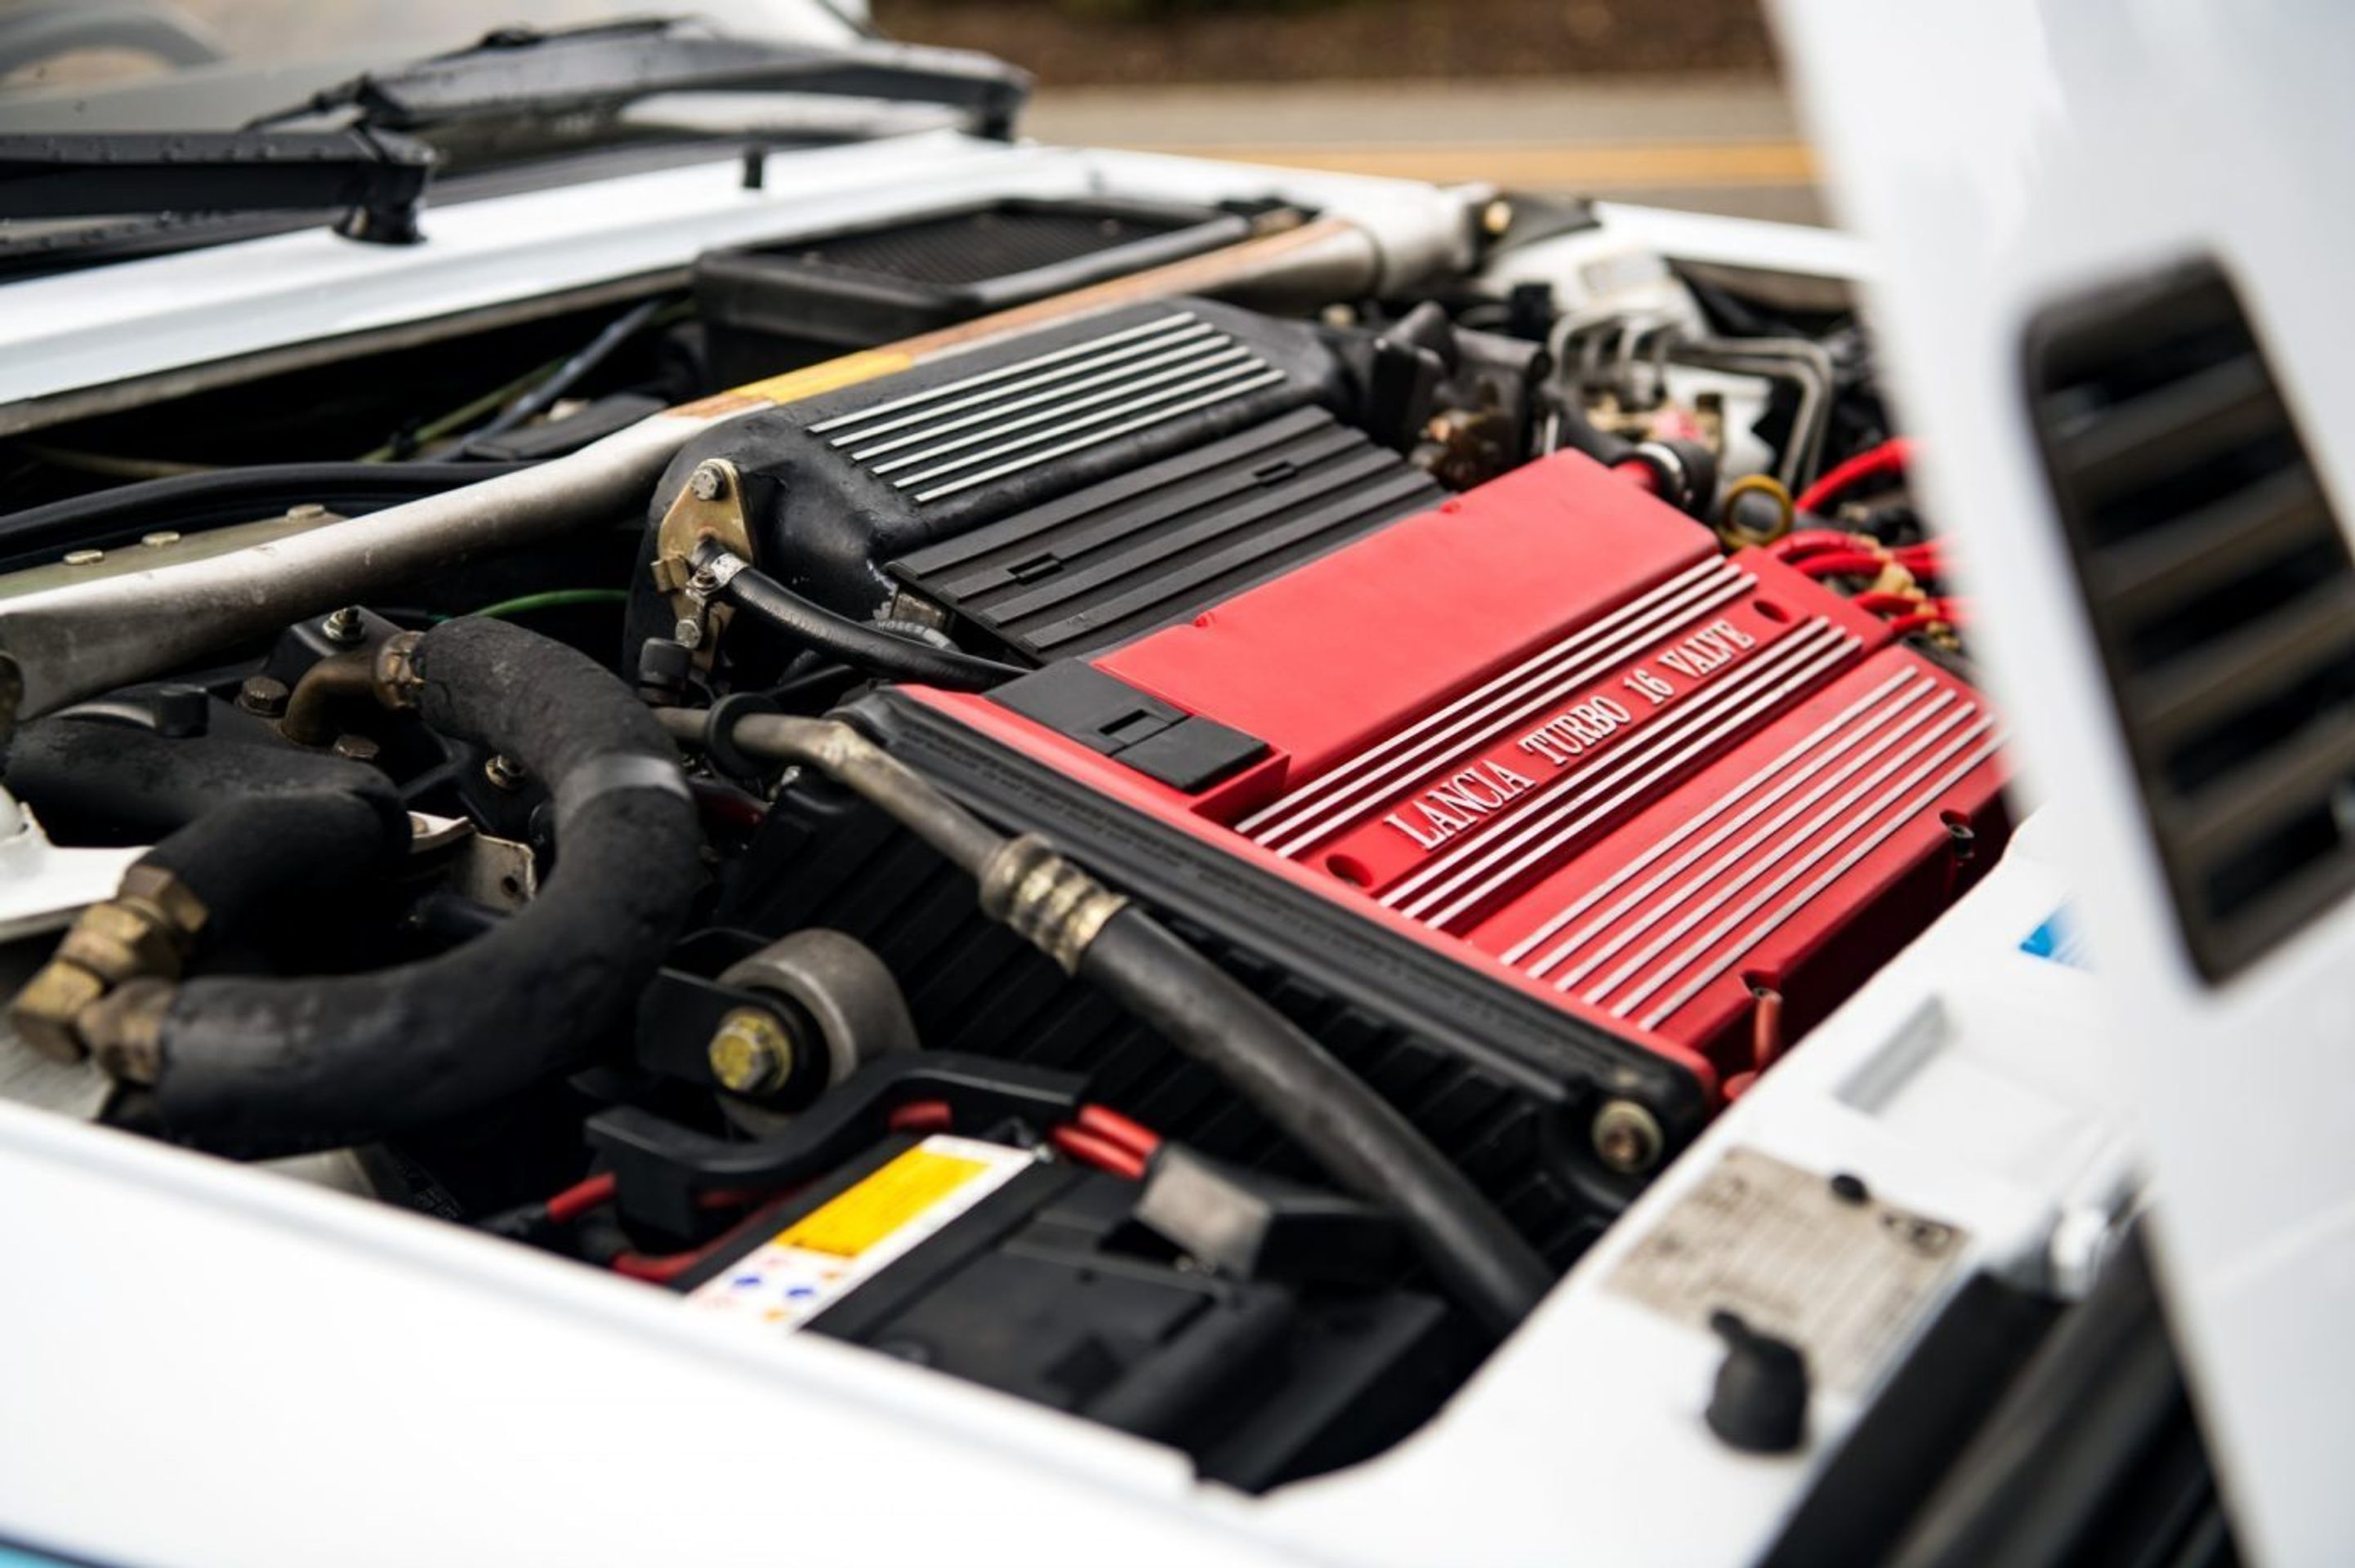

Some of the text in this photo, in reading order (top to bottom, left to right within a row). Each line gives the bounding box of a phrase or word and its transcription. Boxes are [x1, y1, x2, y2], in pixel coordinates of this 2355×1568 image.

[1384, 619, 1756, 849] LANCIA TURBO 16 VALVE
